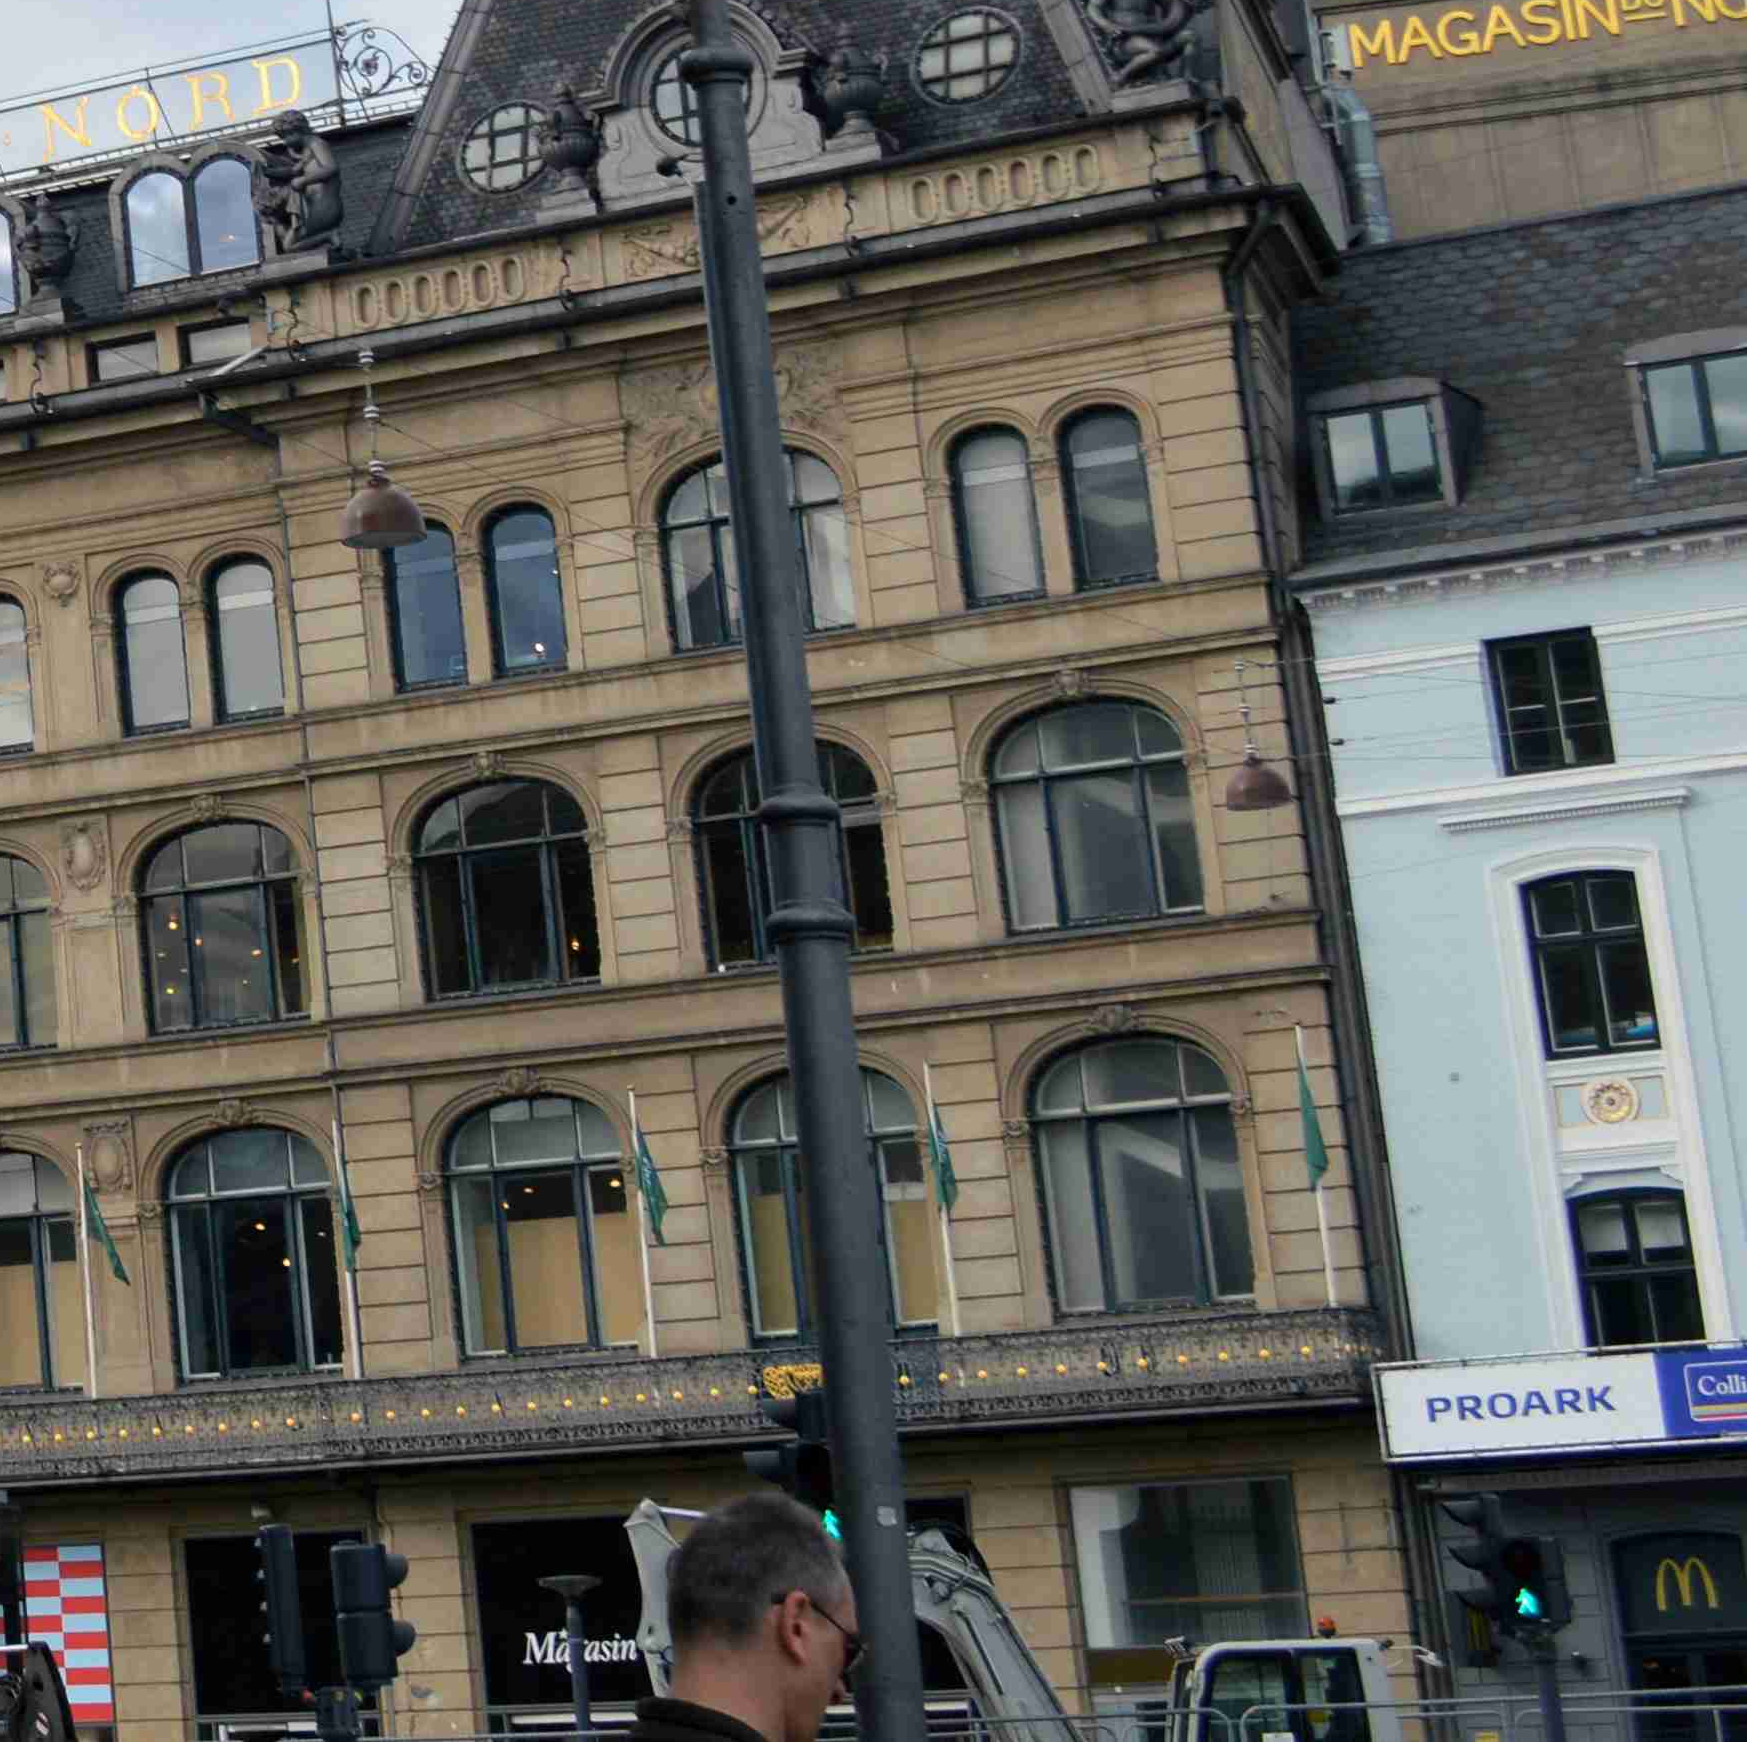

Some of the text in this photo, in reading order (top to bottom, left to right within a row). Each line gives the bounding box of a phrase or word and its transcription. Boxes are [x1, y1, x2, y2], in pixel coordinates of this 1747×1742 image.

[39, 55, 301, 163] NORD
[1425, 1384, 1617, 1424] PROARK
[522, 1628, 638, 1673] Maasin
